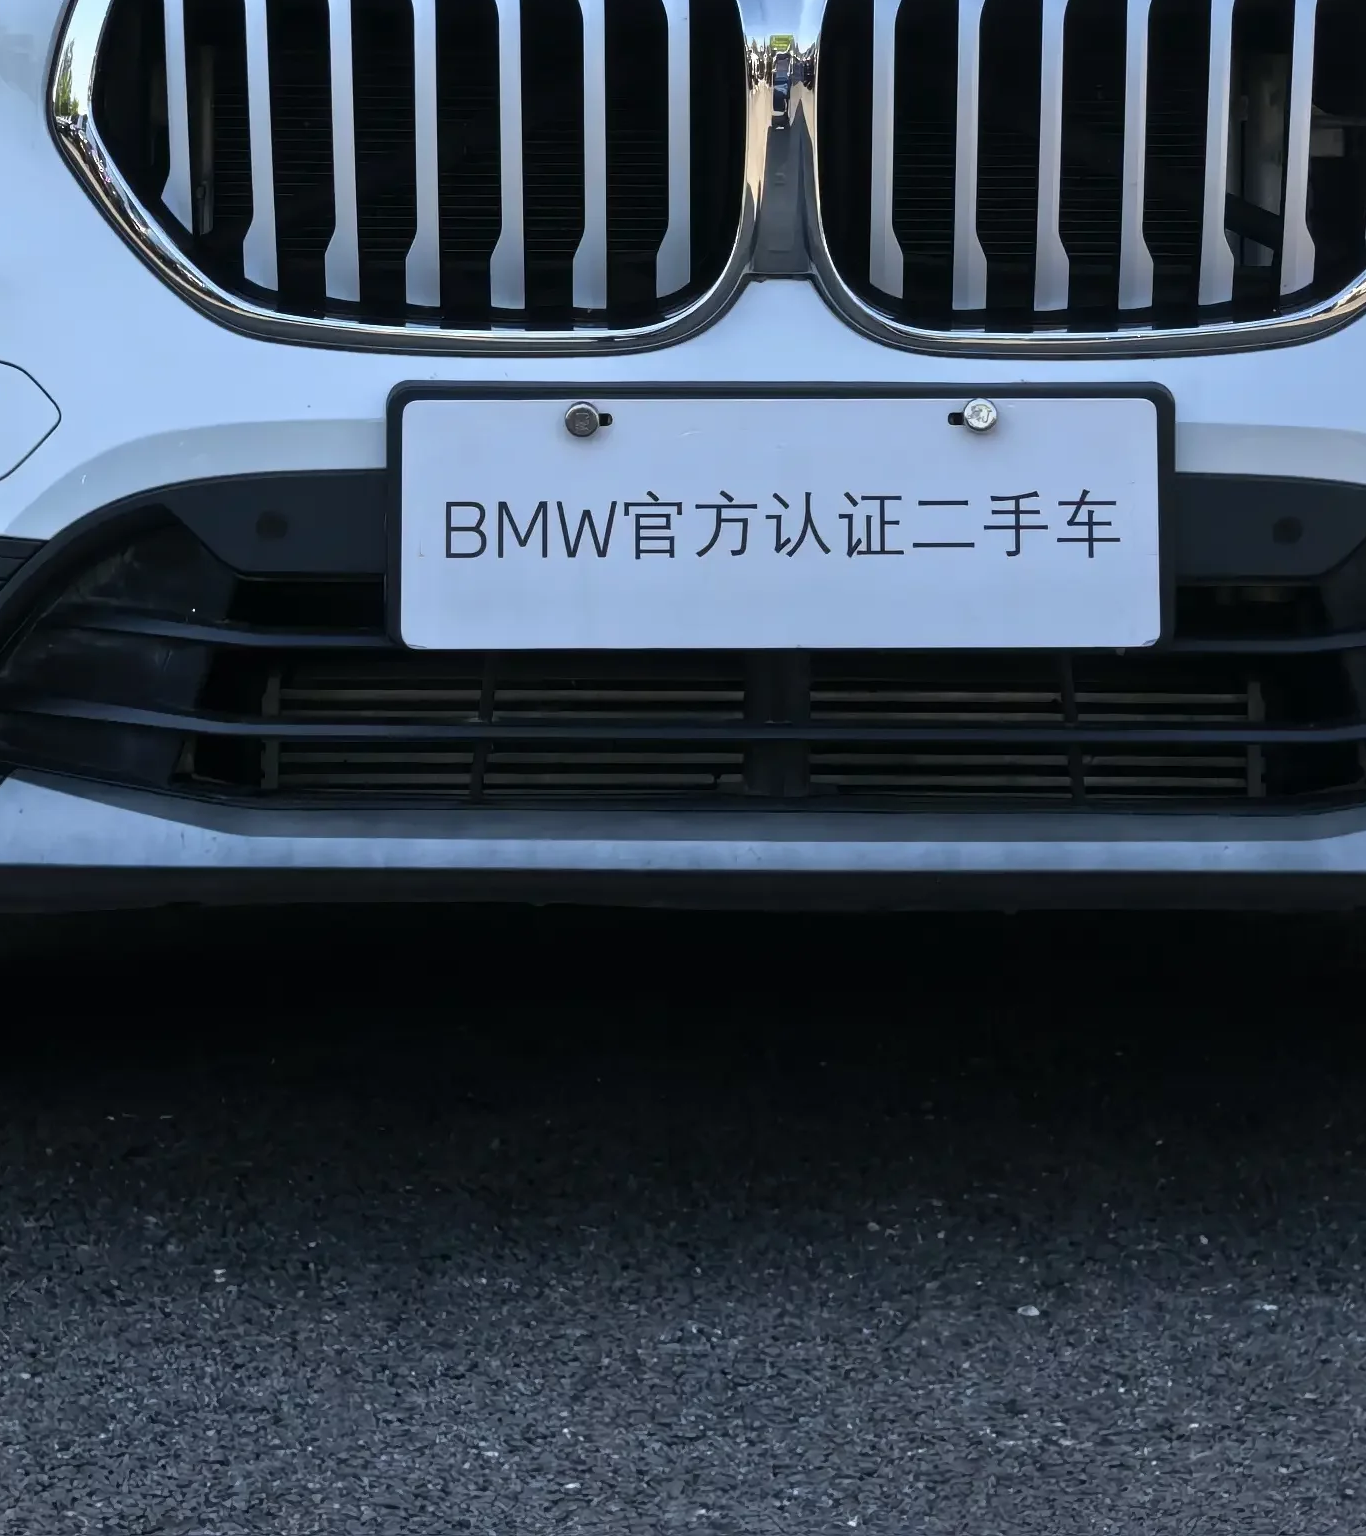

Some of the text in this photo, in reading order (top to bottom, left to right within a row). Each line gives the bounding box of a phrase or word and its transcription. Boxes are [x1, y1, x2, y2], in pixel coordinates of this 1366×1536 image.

[444, 487, 1122, 560] BMW官方认证二手车
